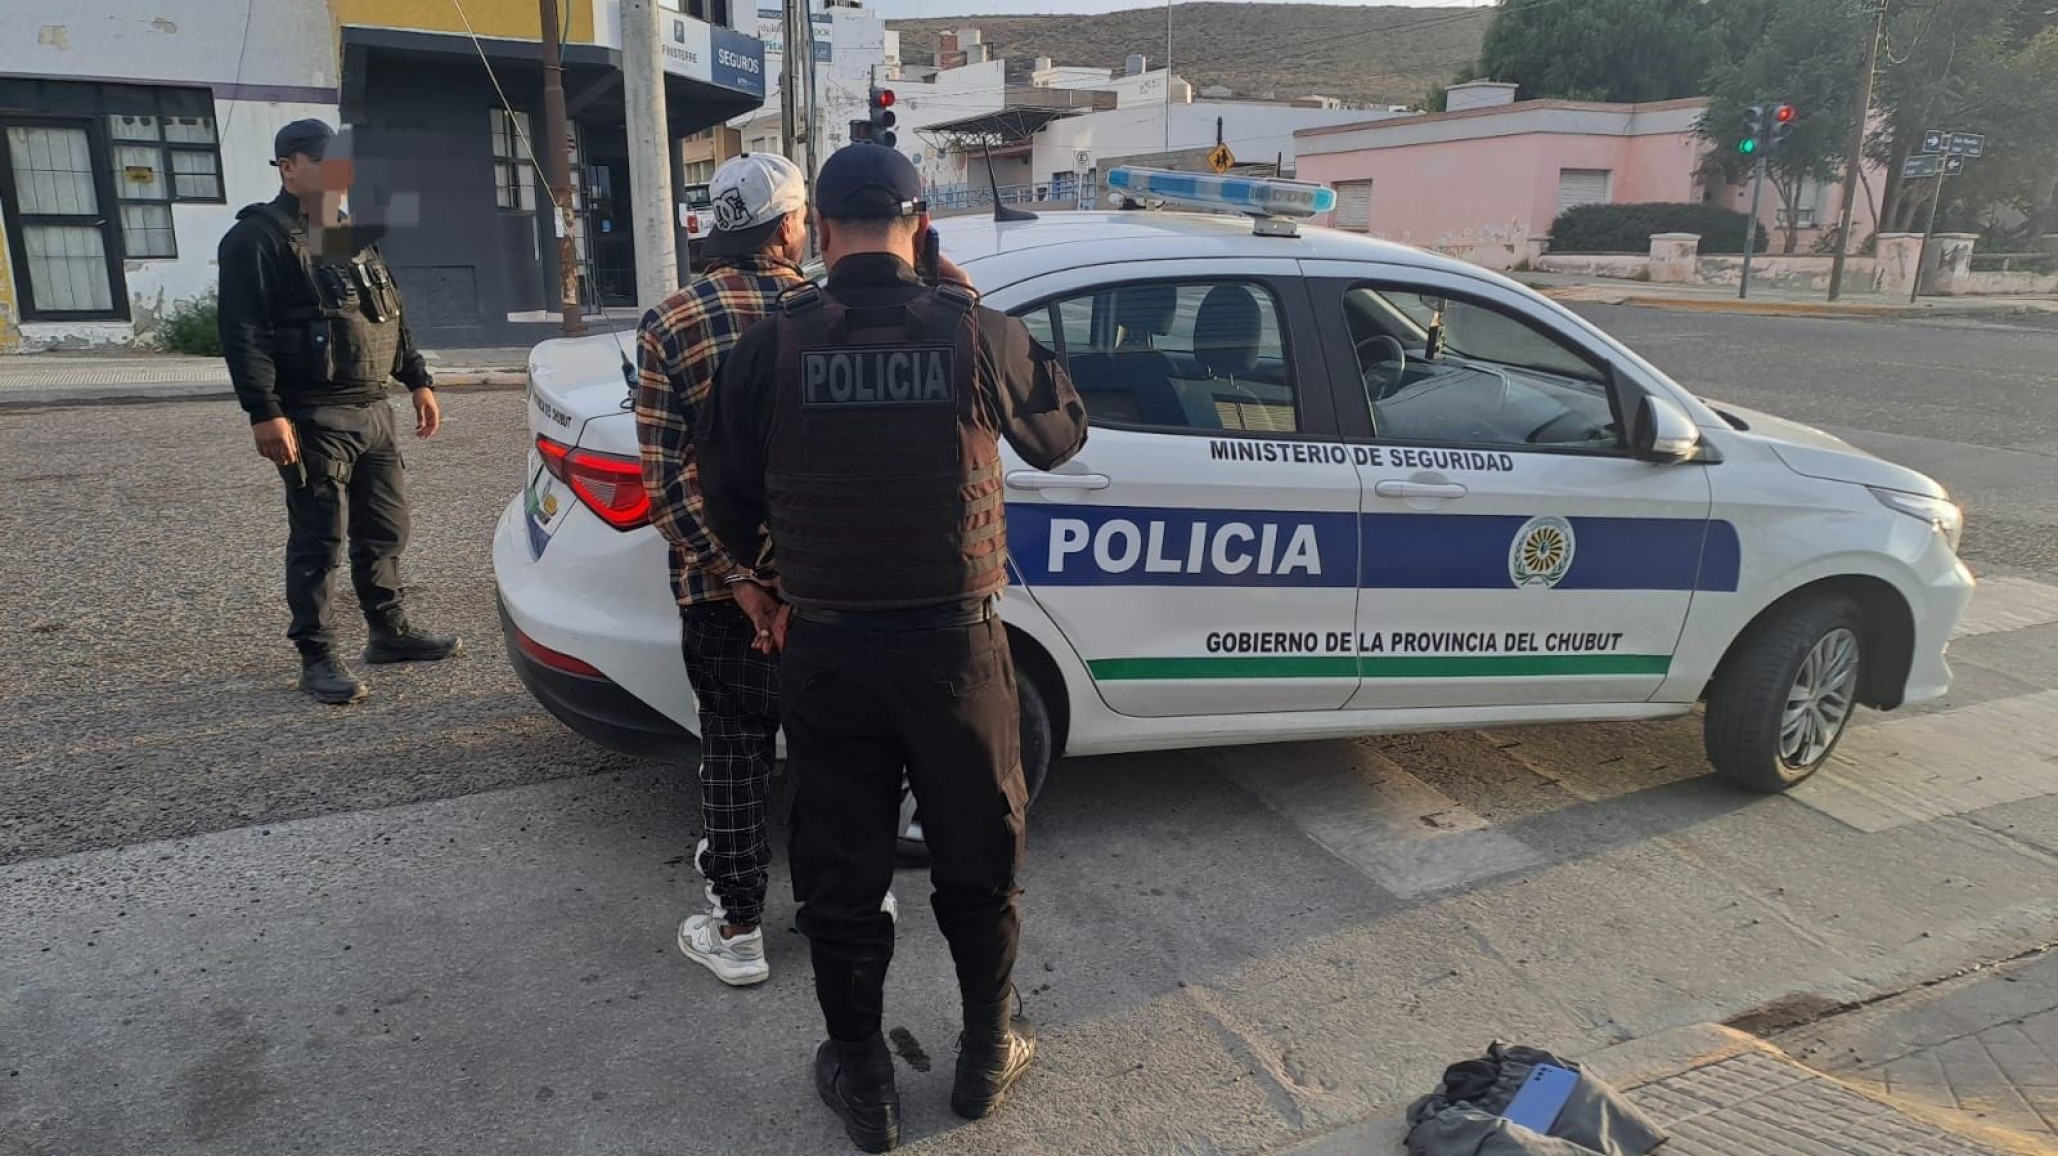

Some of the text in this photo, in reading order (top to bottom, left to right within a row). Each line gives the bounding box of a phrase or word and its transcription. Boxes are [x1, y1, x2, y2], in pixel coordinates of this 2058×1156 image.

[718, 48, 760, 74] SEGUROS
[806, 351, 949, 402] POLICIA
[1210, 440, 1514, 472] MINISTERIO DE SEGURIDAD
[1048, 518, 1322, 575] POLICIA
[1206, 632, 1623, 653] GOBIERNO DE LA PROVINCIA DEL CHUBUT
